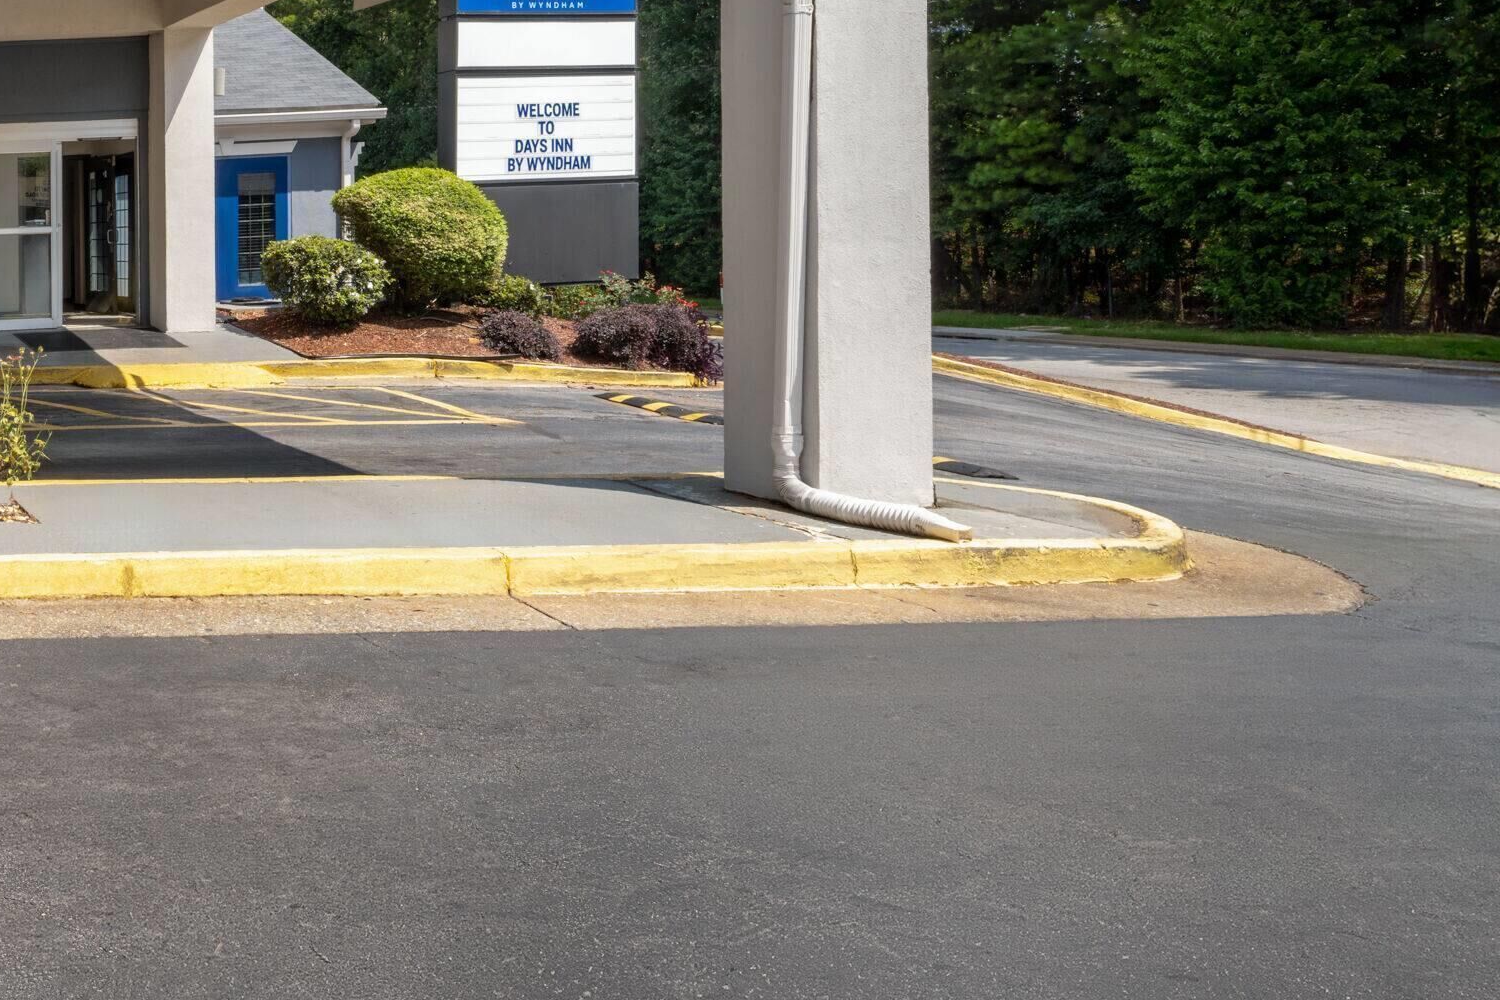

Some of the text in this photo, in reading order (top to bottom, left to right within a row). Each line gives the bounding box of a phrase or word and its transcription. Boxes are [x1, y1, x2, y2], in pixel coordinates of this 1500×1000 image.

[511, 1, 584, 9] BY WYNDHAM
[516, 102, 580, 118] WELCOME
[538, 120, 555, 135] TO
[515, 138, 573, 153] DAYS INN
[508, 155, 591, 172] BY WYNDHAM
